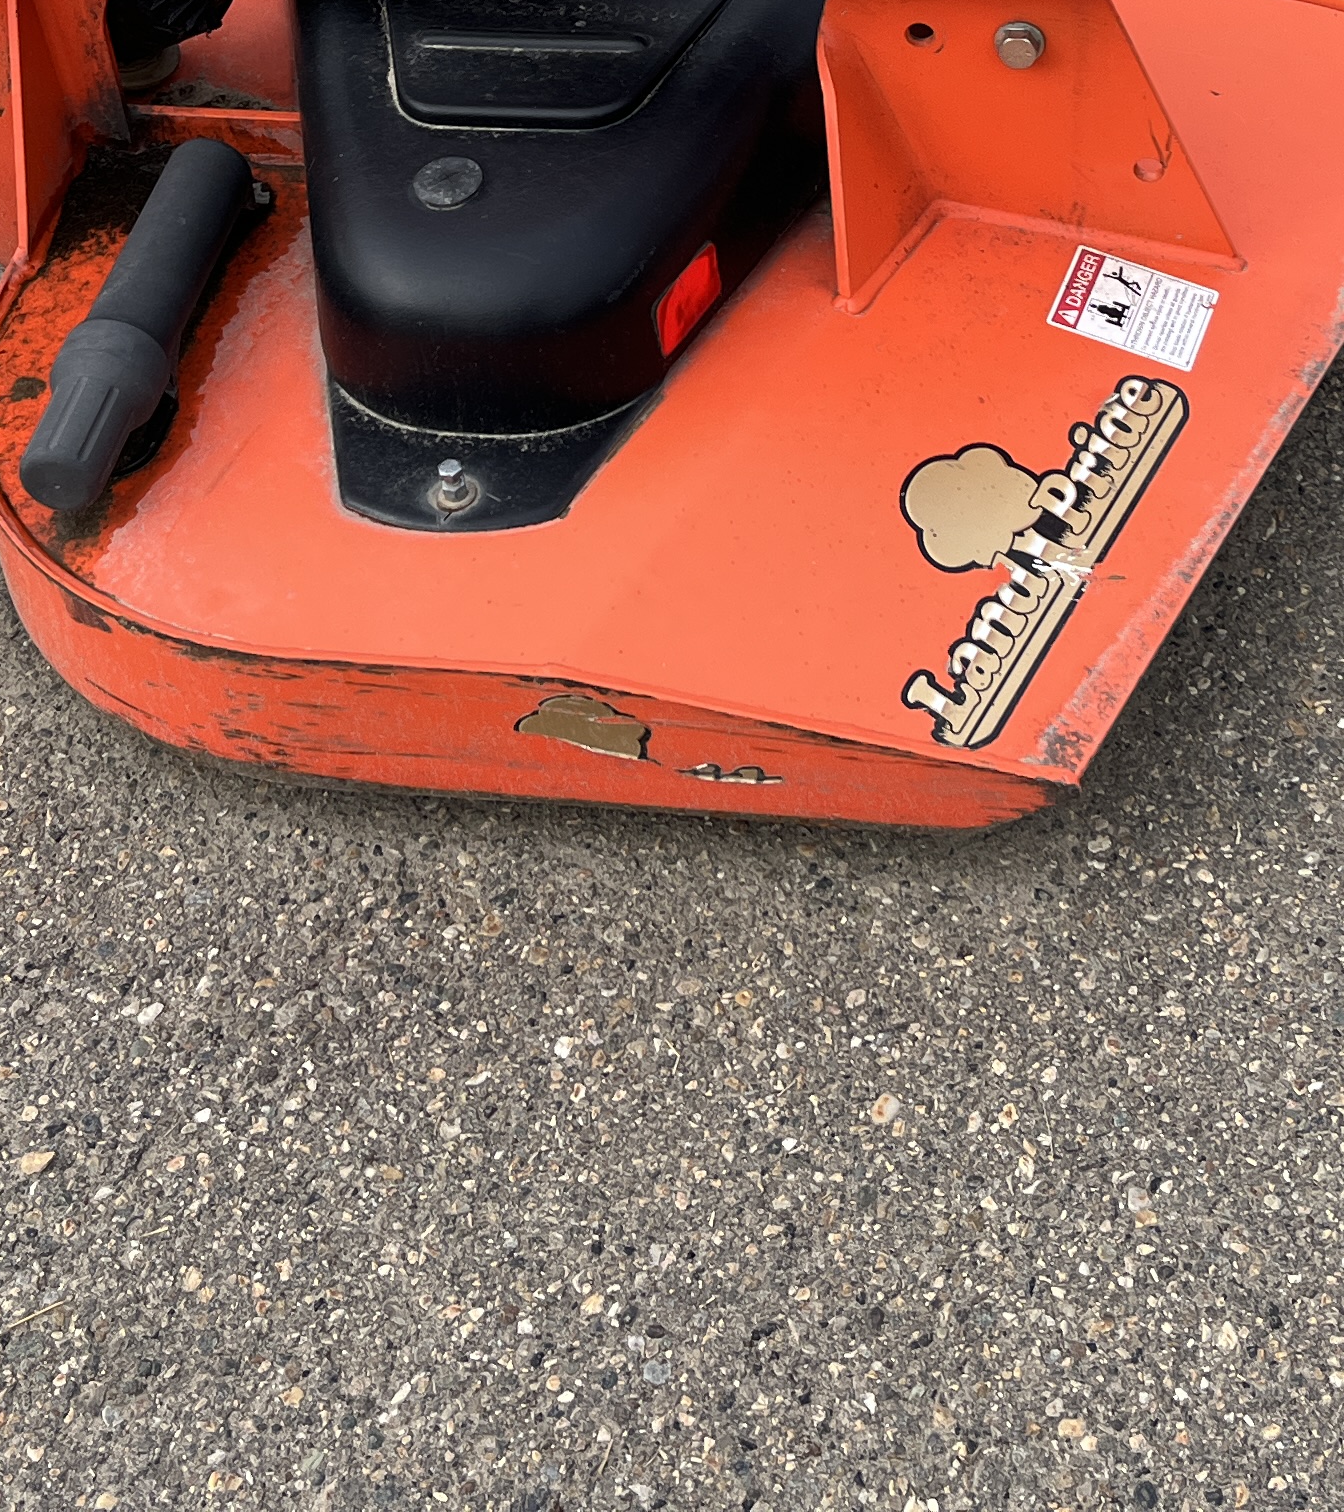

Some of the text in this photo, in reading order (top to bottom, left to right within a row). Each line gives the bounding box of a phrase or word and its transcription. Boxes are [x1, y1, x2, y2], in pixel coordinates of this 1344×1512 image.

[1065, 253, 1100, 308] DANGER
[1149, 276, 1163, 300] HAZARD
[905, 376, 1164, 735] Land Pride
